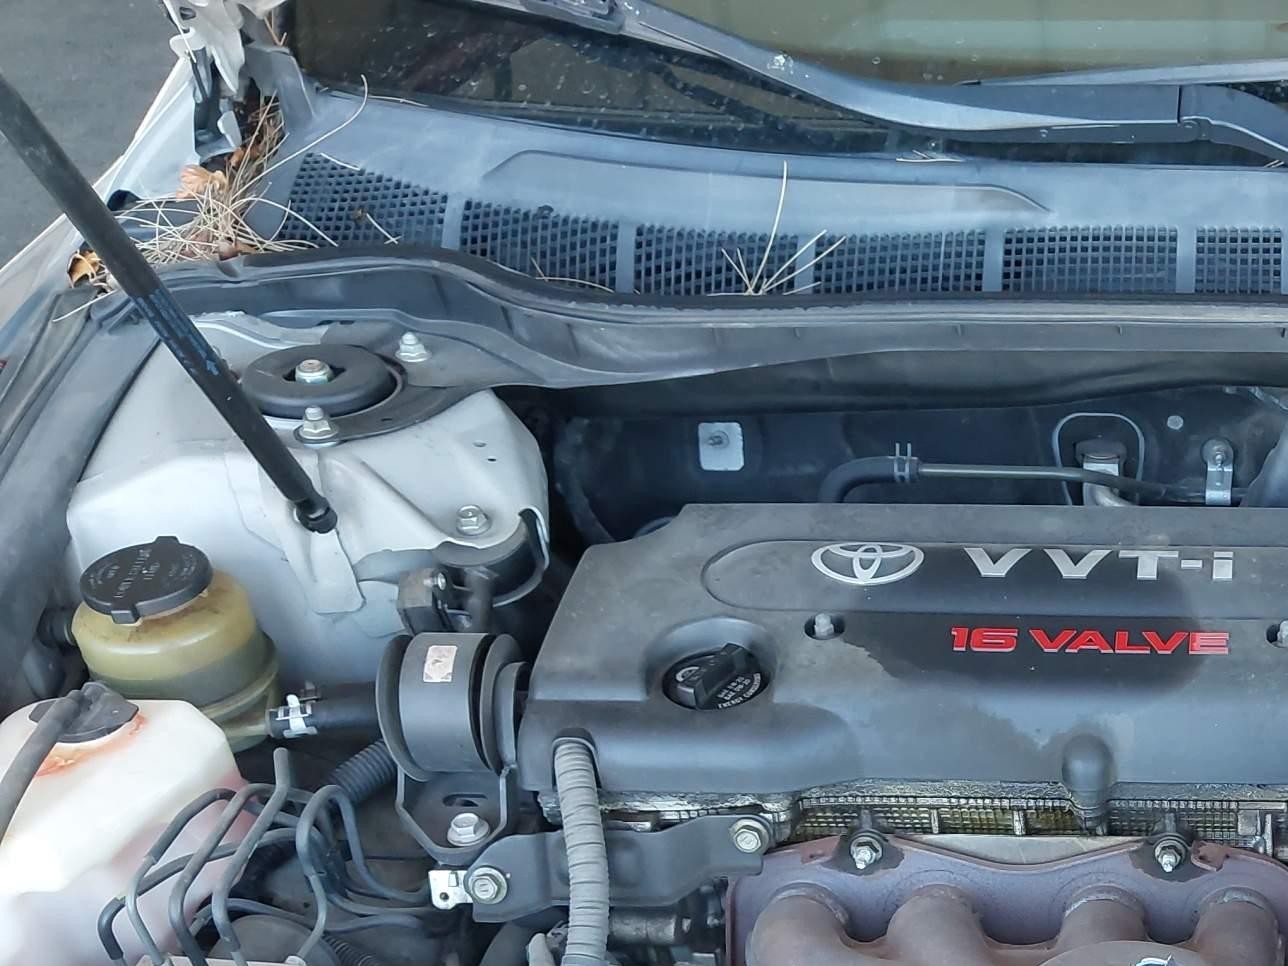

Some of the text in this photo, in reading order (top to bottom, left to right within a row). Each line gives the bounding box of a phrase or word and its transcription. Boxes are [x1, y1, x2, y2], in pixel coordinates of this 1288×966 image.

[963, 547, 1234, 580] VVT-i
[951, 627, 1229, 655] 16 VALVE
